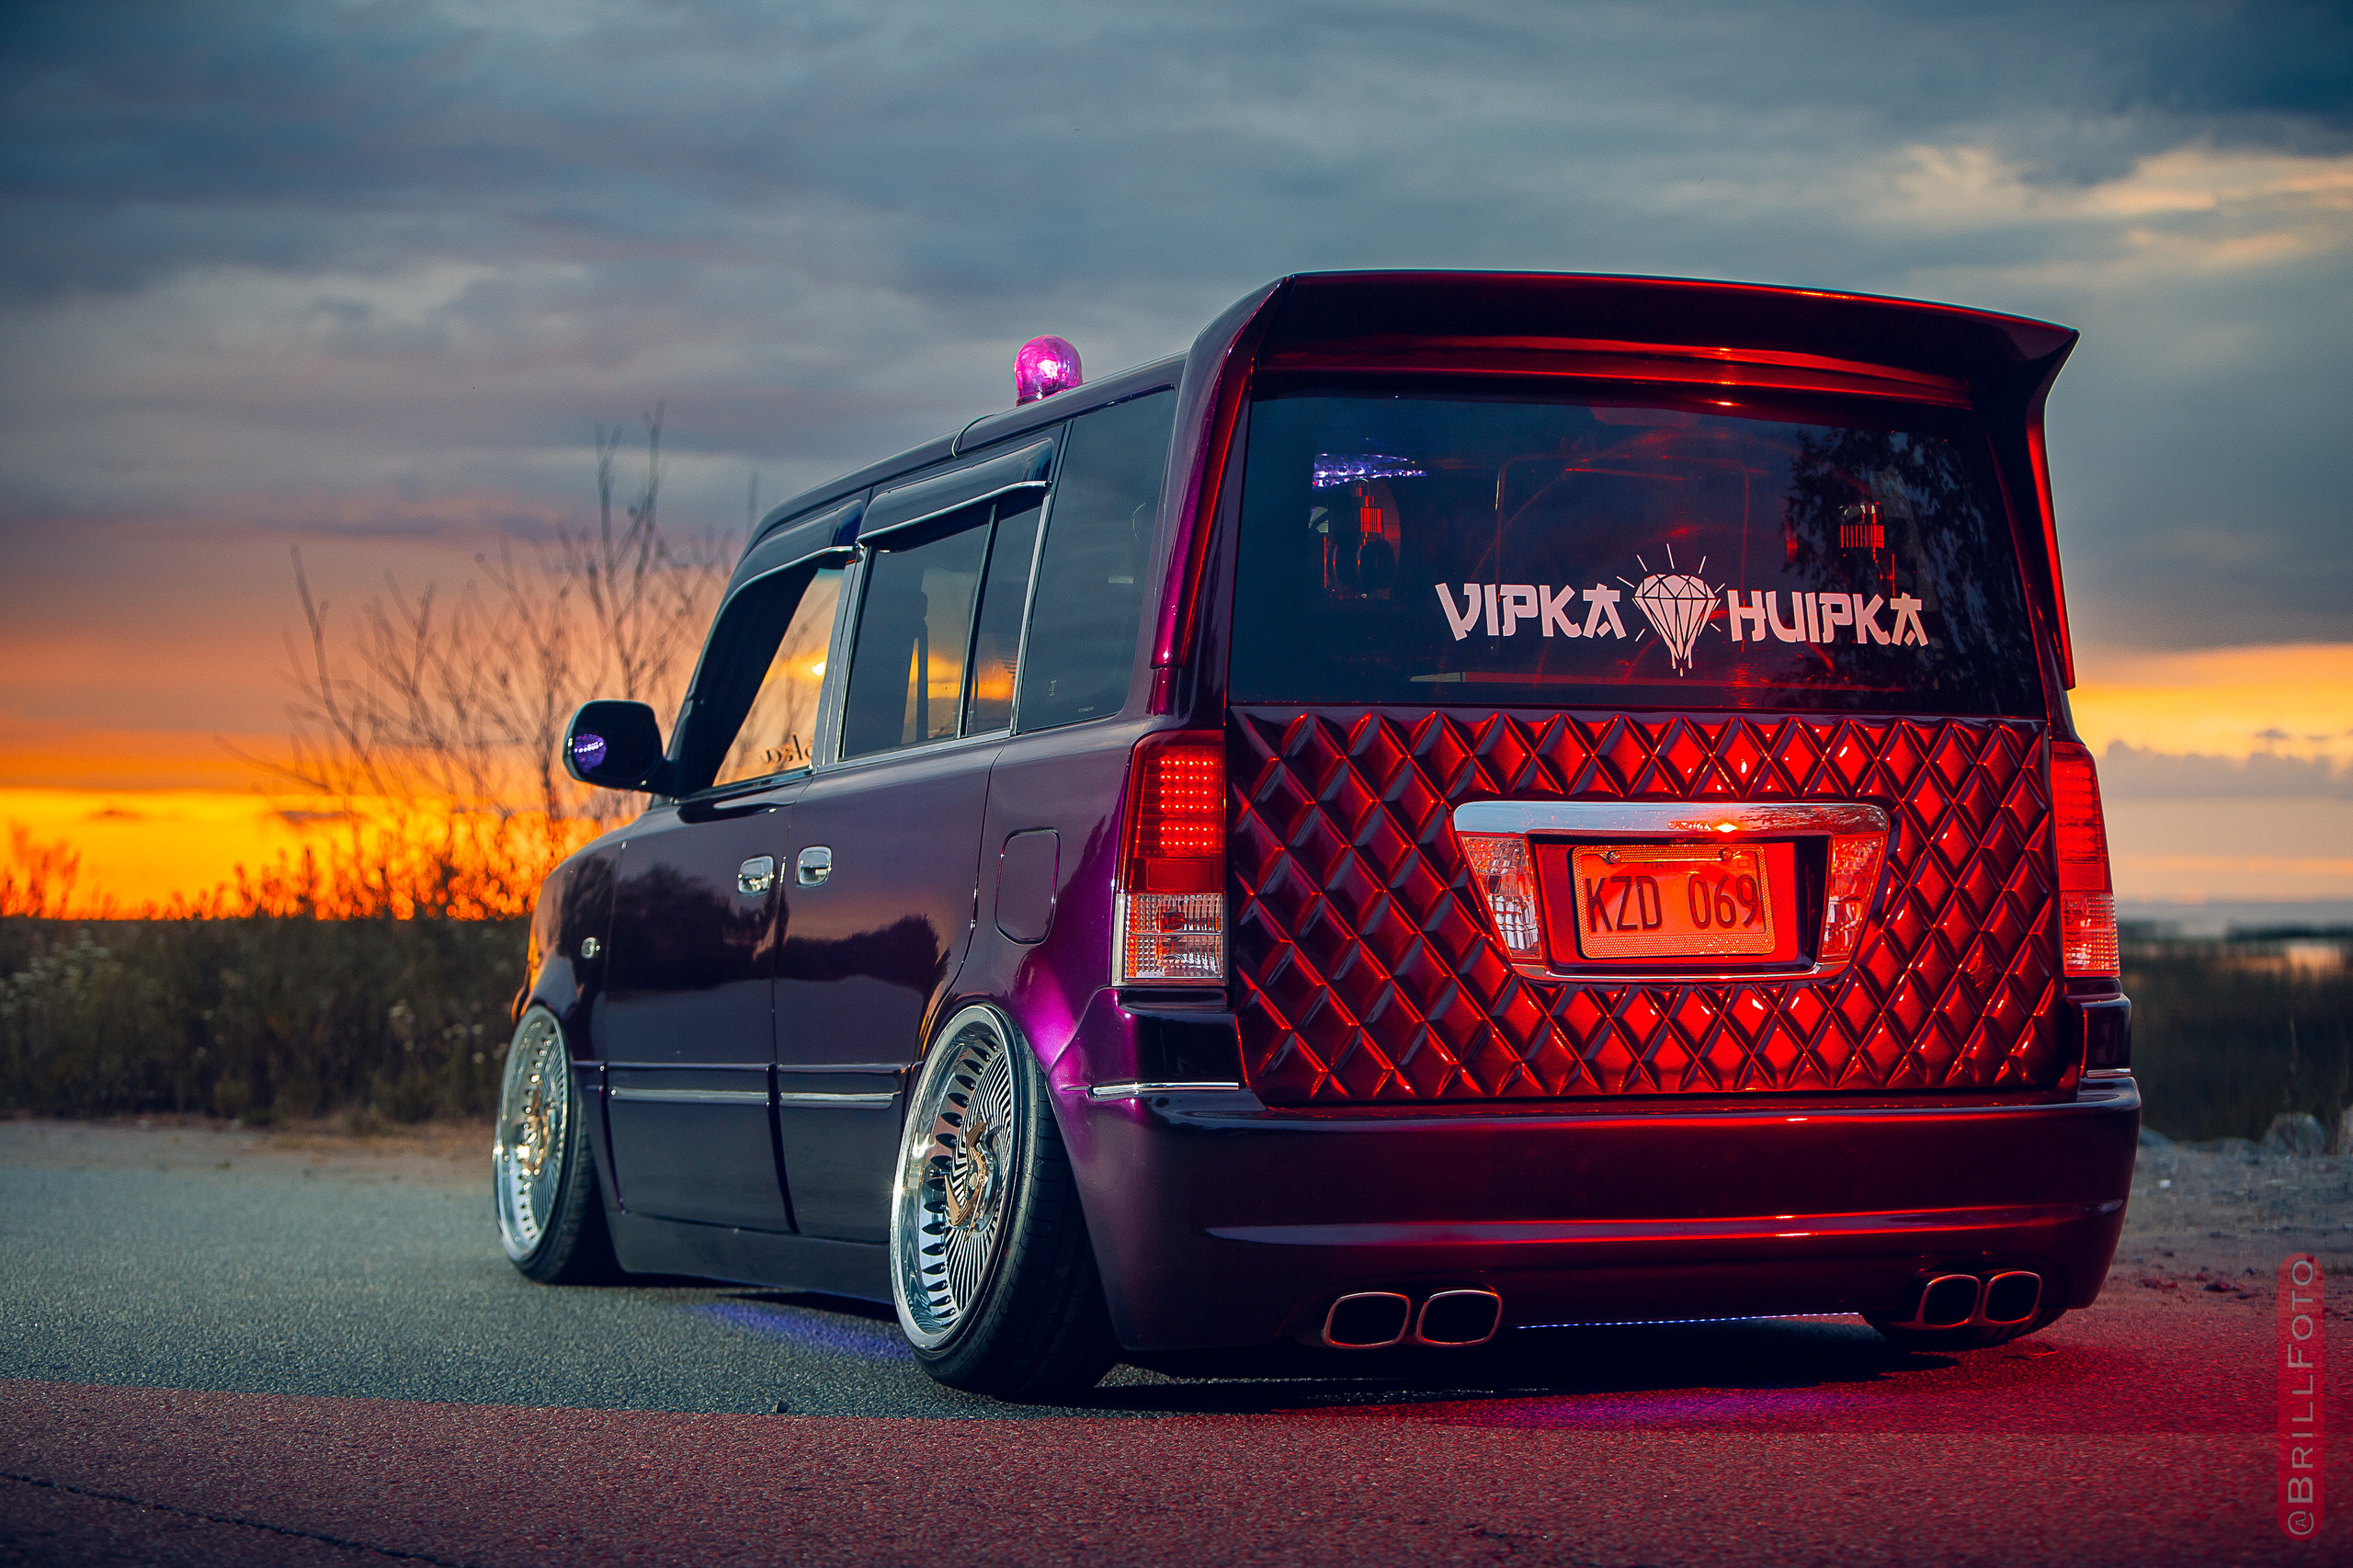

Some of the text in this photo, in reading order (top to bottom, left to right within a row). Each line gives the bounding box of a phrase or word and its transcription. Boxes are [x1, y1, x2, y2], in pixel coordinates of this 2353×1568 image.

[1435, 583, 1928, 647] VIPKA HUIPKA
[1585, 874, 1759, 933] KZD 069
